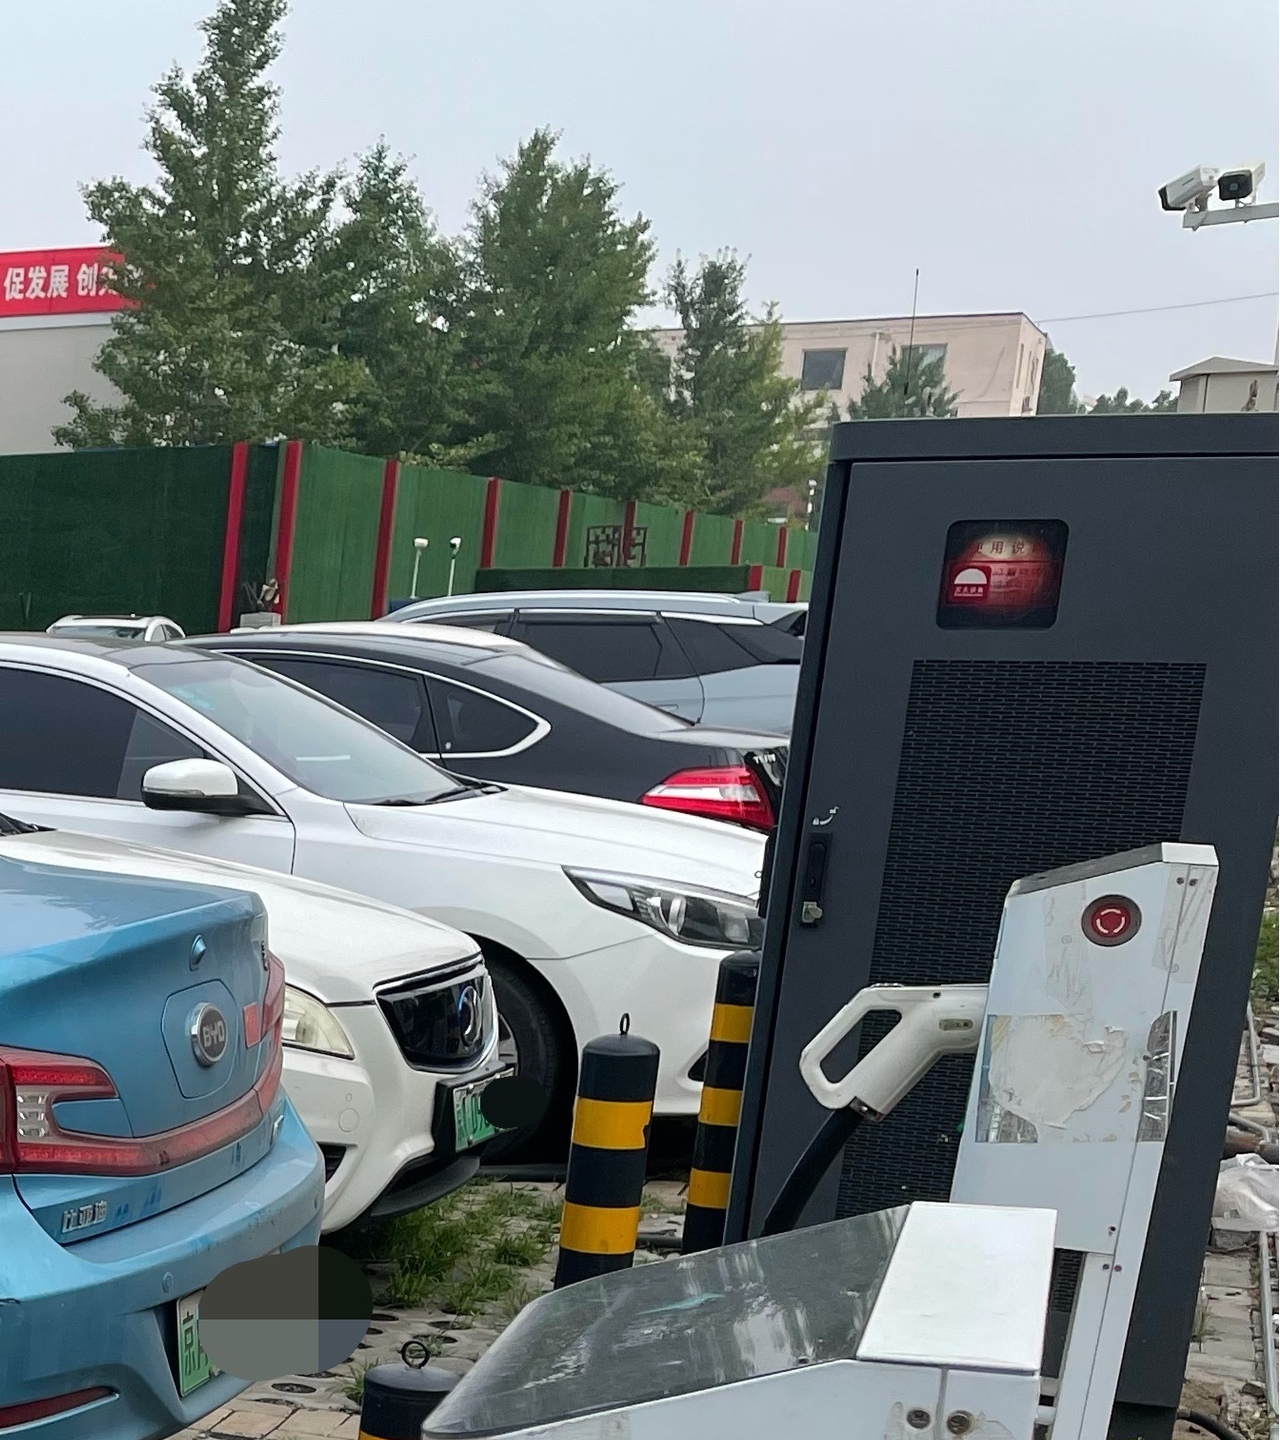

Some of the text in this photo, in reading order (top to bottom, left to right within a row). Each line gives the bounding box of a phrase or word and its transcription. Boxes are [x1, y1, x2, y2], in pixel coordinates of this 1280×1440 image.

[4, 265, 69, 301] 促发展
[202, 1020, 225, 1048] BYD
